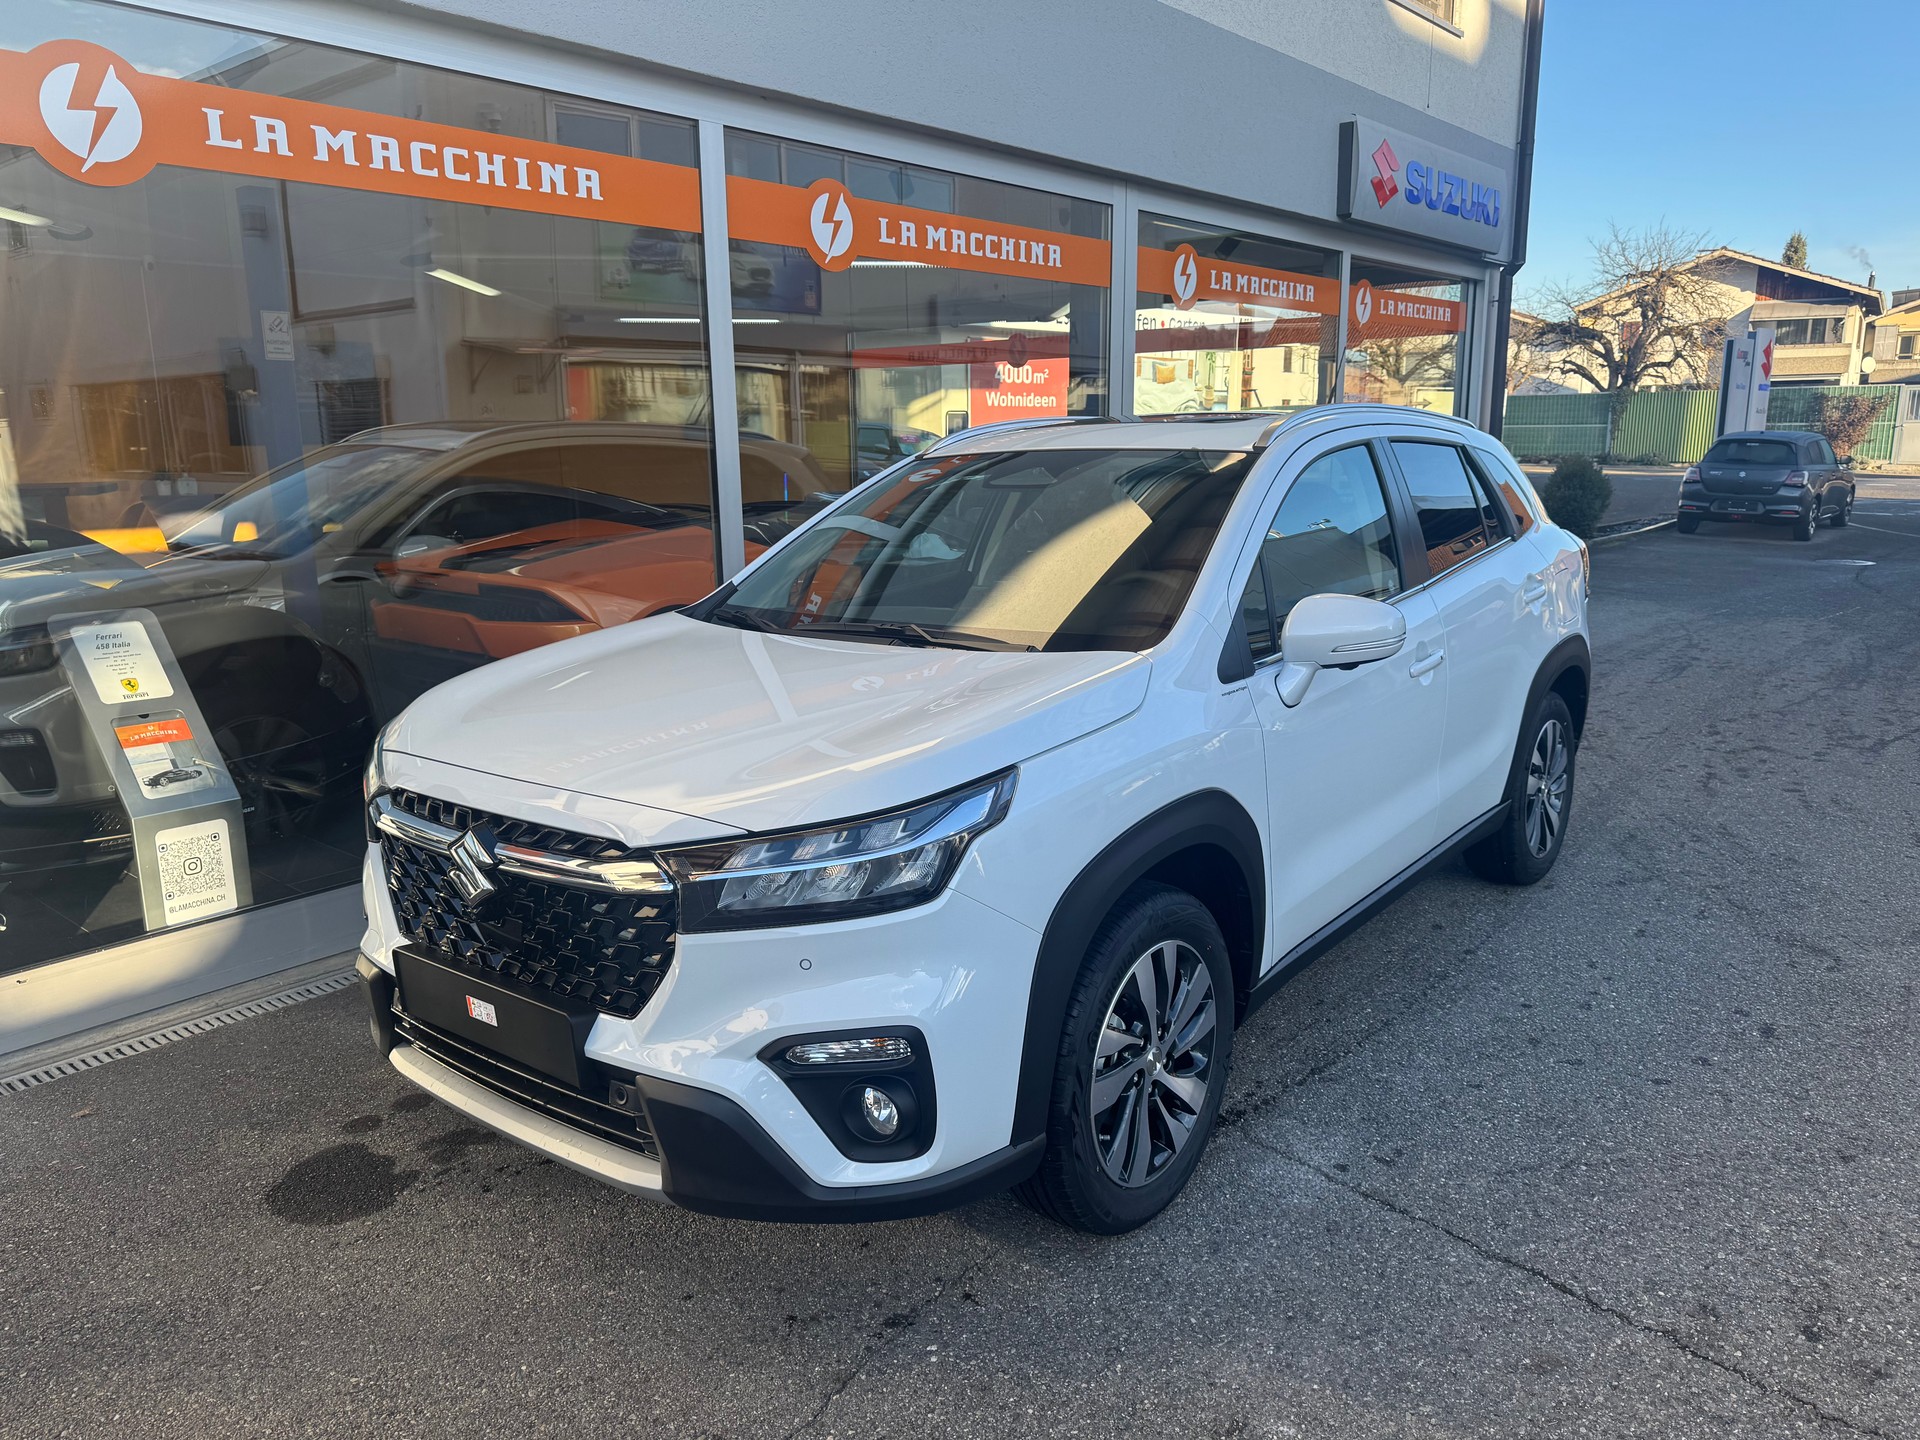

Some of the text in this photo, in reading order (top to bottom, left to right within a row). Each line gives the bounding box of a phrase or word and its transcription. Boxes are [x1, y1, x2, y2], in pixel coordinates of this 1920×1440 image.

[202, 107, 604, 200] LA MACCHINA
[1405, 160, 1500, 228] SUZUKI
[878, 217, 1062, 268] LA MACCHINA
[1210, 270, 1315, 303] LA MACCHINA
[1379, 299, 1451, 322] LA MACCHINA
[995, 363, 1033, 384] 4000
[985, 391, 1057, 407] Wohnideen
[95, 632, 122, 641] Ferrari
[112, 641, 131, 649] Italia
[169, 894, 226, 914] @LAMACCHINA.CH
